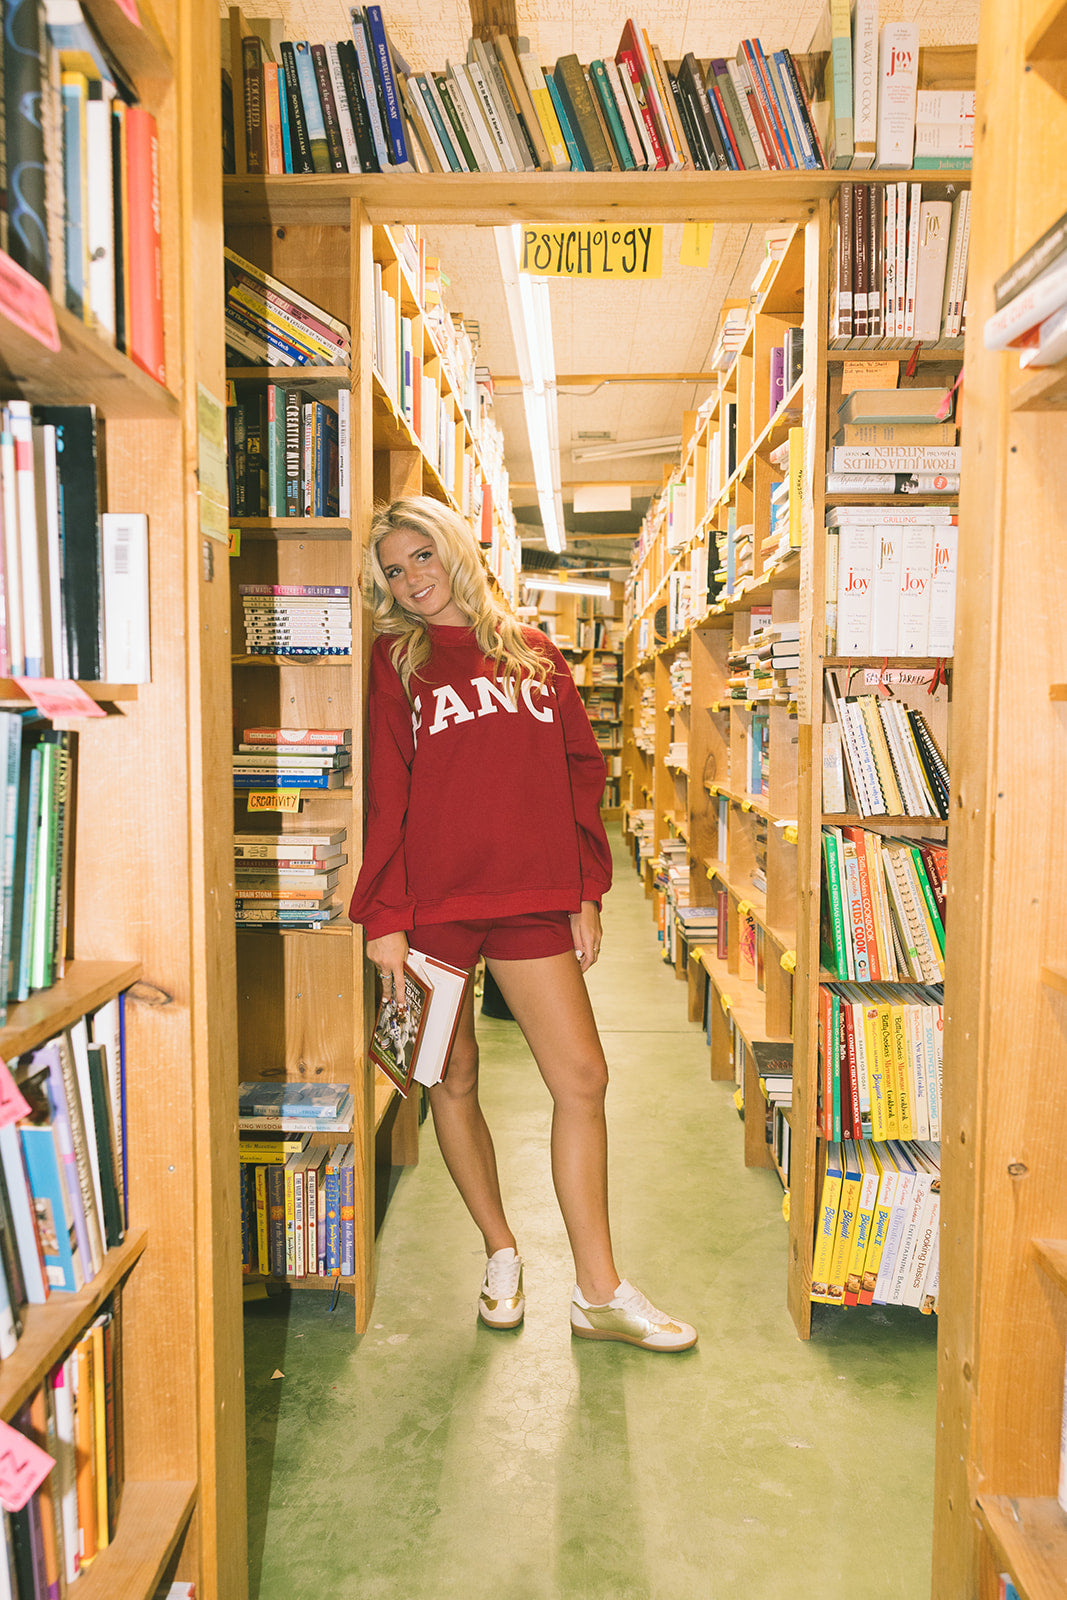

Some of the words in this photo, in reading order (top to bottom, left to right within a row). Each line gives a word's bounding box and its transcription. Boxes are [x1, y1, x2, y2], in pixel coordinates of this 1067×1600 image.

[863, 15, 872, 36] THE
[314, 50, 323, 66] now
[353, 26, 369, 63] Preparing
[782, 50, 792, 66] LIVING
[862, 40, 872, 67] WAY
[362, 64, 371, 77] for
[886, 47, 912, 76] joy
[365, 78, 375, 94] Life
[669, 78, 679, 93] ART
[862, 70, 872, 86] TO
[250, 76, 259, 127] TOUCHED
[291, 94, 300, 118] DONNA
[322, 88, 331, 101] the
[861, 89, 871, 122] COOK
[324, 103, 333, 125] moon
[732, 78, 754, 120] HIDDEN
[747, 125, 761, 145] ART
[295, 119, 307, 155] WILLIAMS
[803, 122, 815, 144] DORRELL
[523, 227, 652, 274] PSYCHOLOGY
[288, 394, 296, 404] THE
[286, 405, 298, 448] CREATIVE
[286, 451, 298, 476] MIND
[843, 458, 887, 469] CHILD'S
[874, 447, 924, 457] KITCHEN
[888, 456, 921, 469] JULIA
[922, 458, 955, 469] FROM
[865, 473, 874, 485] for
[877, 475, 890, 484] Life
[877, 537, 894, 570] joy
[931, 543, 949, 579] joy
[845, 567, 871, 595] joy
[901, 567, 928, 595] joy
[924, 855, 934, 867] Betty
[831, 883, 840, 916] CHRISTMAS
[856, 853, 867, 871] Betty
[862, 897, 874, 941] COOKBOOK
[851, 898, 862, 924] KIDS
[834, 917, 843, 951] COOKBOOK
[854, 926, 864, 954] COOK
[879, 1014, 890, 1030] Betty
[892, 1017, 903, 1033] Betty
[882, 1030, 891, 1057] Crocker's
[895, 1033, 905, 1059] Crocker's
[925, 1027, 935, 1078] SOUTHWEST
[847, 1033, 855, 1064] COMPLETE
[851, 1091, 859, 1123] COOKBOOK
[870, 1073, 884, 1100] Bisquick
[885, 1089, 895, 1118] Cookbook
[899, 1092, 909, 1121] Cookbook
[928, 1082, 937, 1118] COOKING
[876, 1102, 884, 1129] COOKBOOK
[865, 1178, 875, 1189] Betty
[882, 1185, 891, 1203] Crocker
[883, 1175, 893, 1186] Betty
[864, 1188, 873, 1206] Crocker
[912, 1188, 925, 1204] Betty
[819, 1206, 835, 1236] Bisquick
[837, 1209, 853, 1240] Bisquick
[855, 1213, 870, 1240] Bisquick
[873, 1210, 888, 1237] Bisquick
[889, 1206, 905, 1241] Ultimate
[856, 1241, 865, 1249] II
[873, 1238, 882, 1246] II
[885, 1241, 897, 1261] cake
[898, 1223, 916, 1273] ENTERTAINING
[917, 1227, 934, 1261] cooking
[817, 1236, 828, 1276] COOKBOOK
[834, 1239, 846, 1279] COOKBOOK
[881, 1261, 893, 1278] mix
[892, 1274, 904, 1300] BASICS
[911, 1261, 927, 1289] basics
